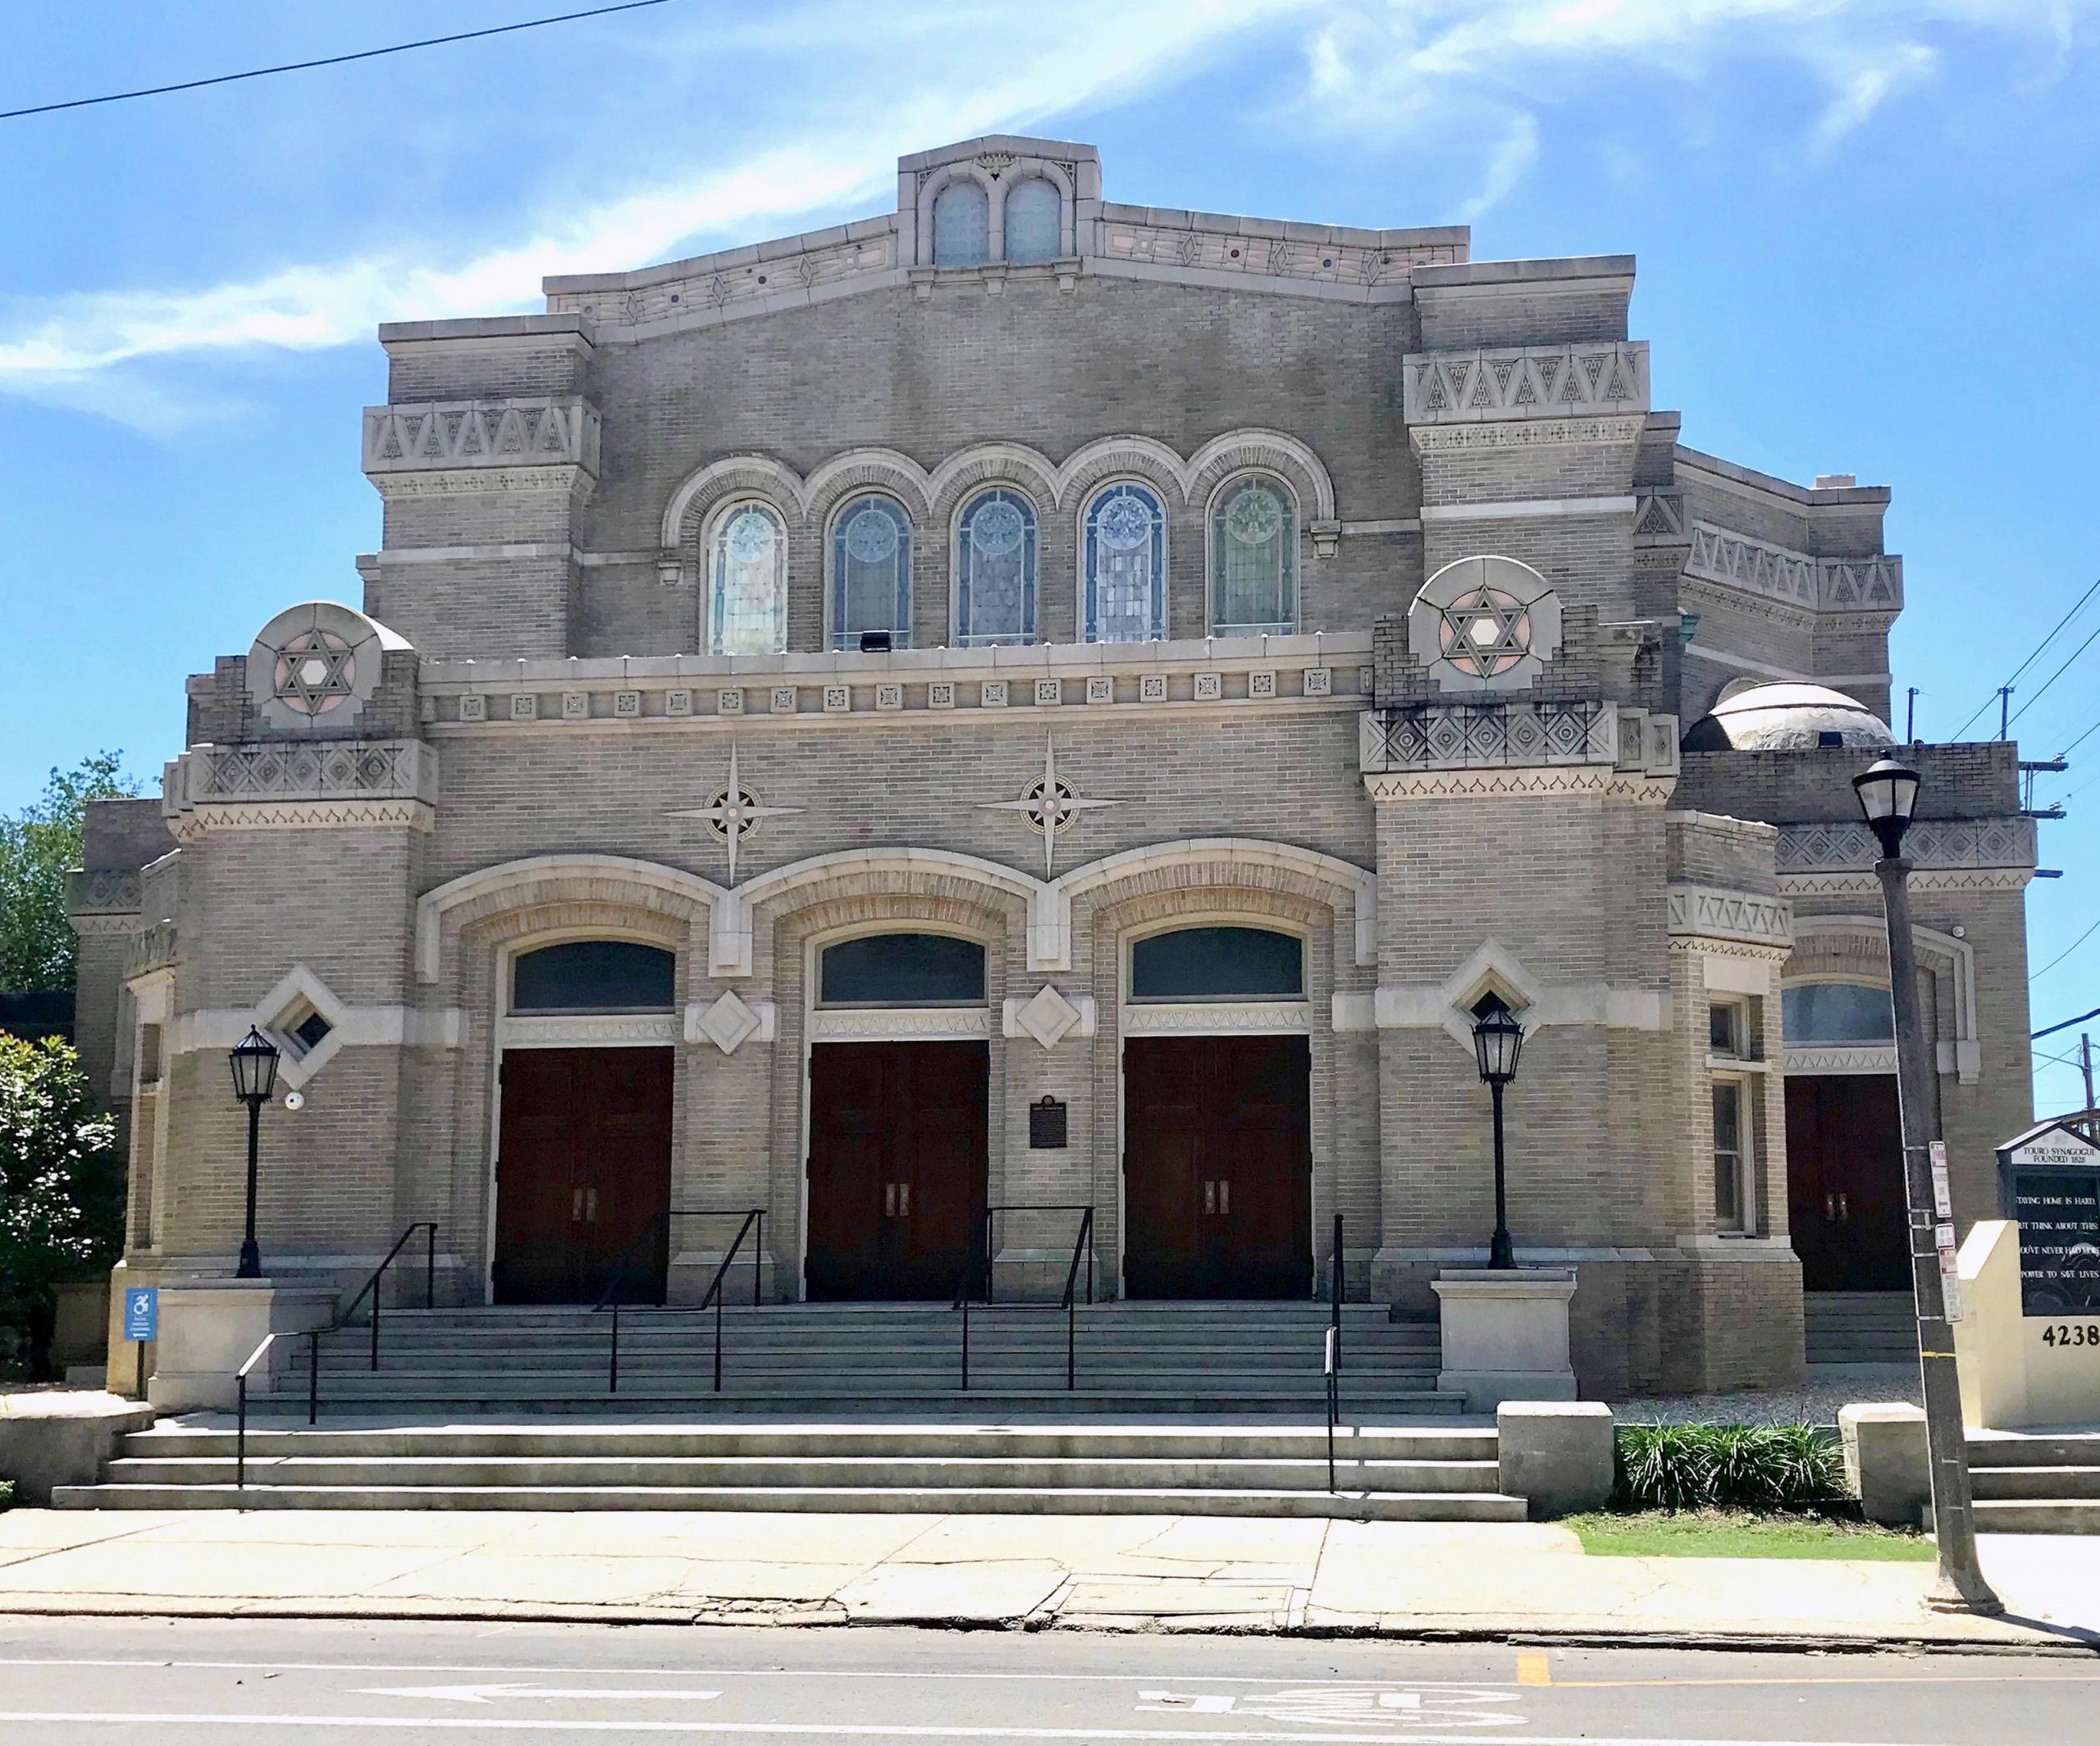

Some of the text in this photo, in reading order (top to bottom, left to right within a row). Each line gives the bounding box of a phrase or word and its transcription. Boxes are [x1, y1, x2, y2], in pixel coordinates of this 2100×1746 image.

[2024, 1147, 2096, 1156] TOURO SYNAGOGUE
[2016, 1196, 2041, 1204] TAYING
[2043, 1197, 2062, 1205] HOME
[2066, 1197, 2073, 1205] IS
[2030, 1222, 2052, 1230] THINK
[2055, 1222, 2078, 1230] ABOUT
[2020, 1245, 2040, 1255] OU'VE
[2042, 1246, 2064, 1255] NEVER
[2065, 1246, 2081, 1255] HAD
[2021, 1270, 2043, 1278] POWER
[2047, 1270, 2057, 1278] TO
[2043, 1325, 2100, 1347] 4238
